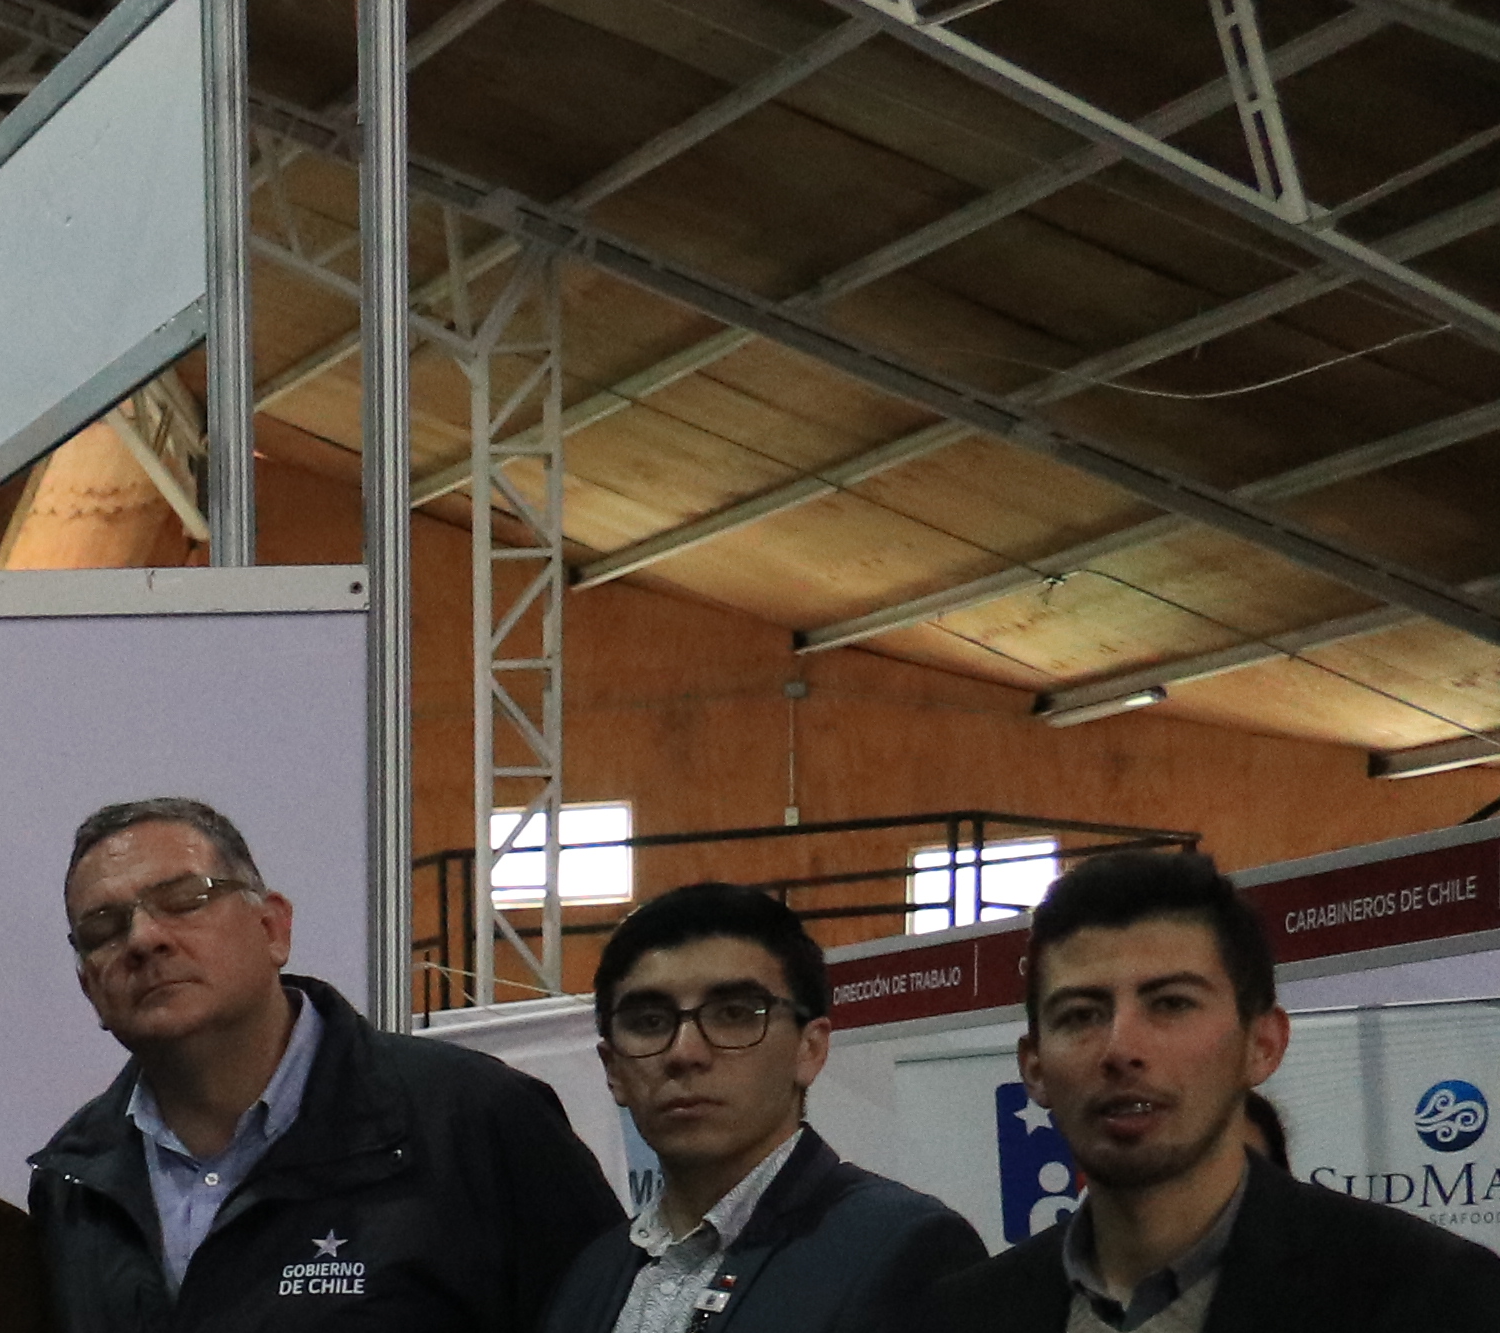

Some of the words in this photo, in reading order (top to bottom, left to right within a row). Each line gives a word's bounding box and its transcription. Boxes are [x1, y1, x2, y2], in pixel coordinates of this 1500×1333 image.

[1285, 892, 1396, 934] CARABINEROS
[1400, 886, 1423, 912] DE
[1427, 875, 1478, 907] CHILE
[832, 974, 890, 1006] DIRECCIÓN
[892, 975, 907, 994] DE
[908, 966, 962, 992] TRABAJO
[282, 1262, 366, 1279] GOBIERNO
[278, 1279, 305, 1296] DE
[307, 1278, 366, 1295] CHILE
